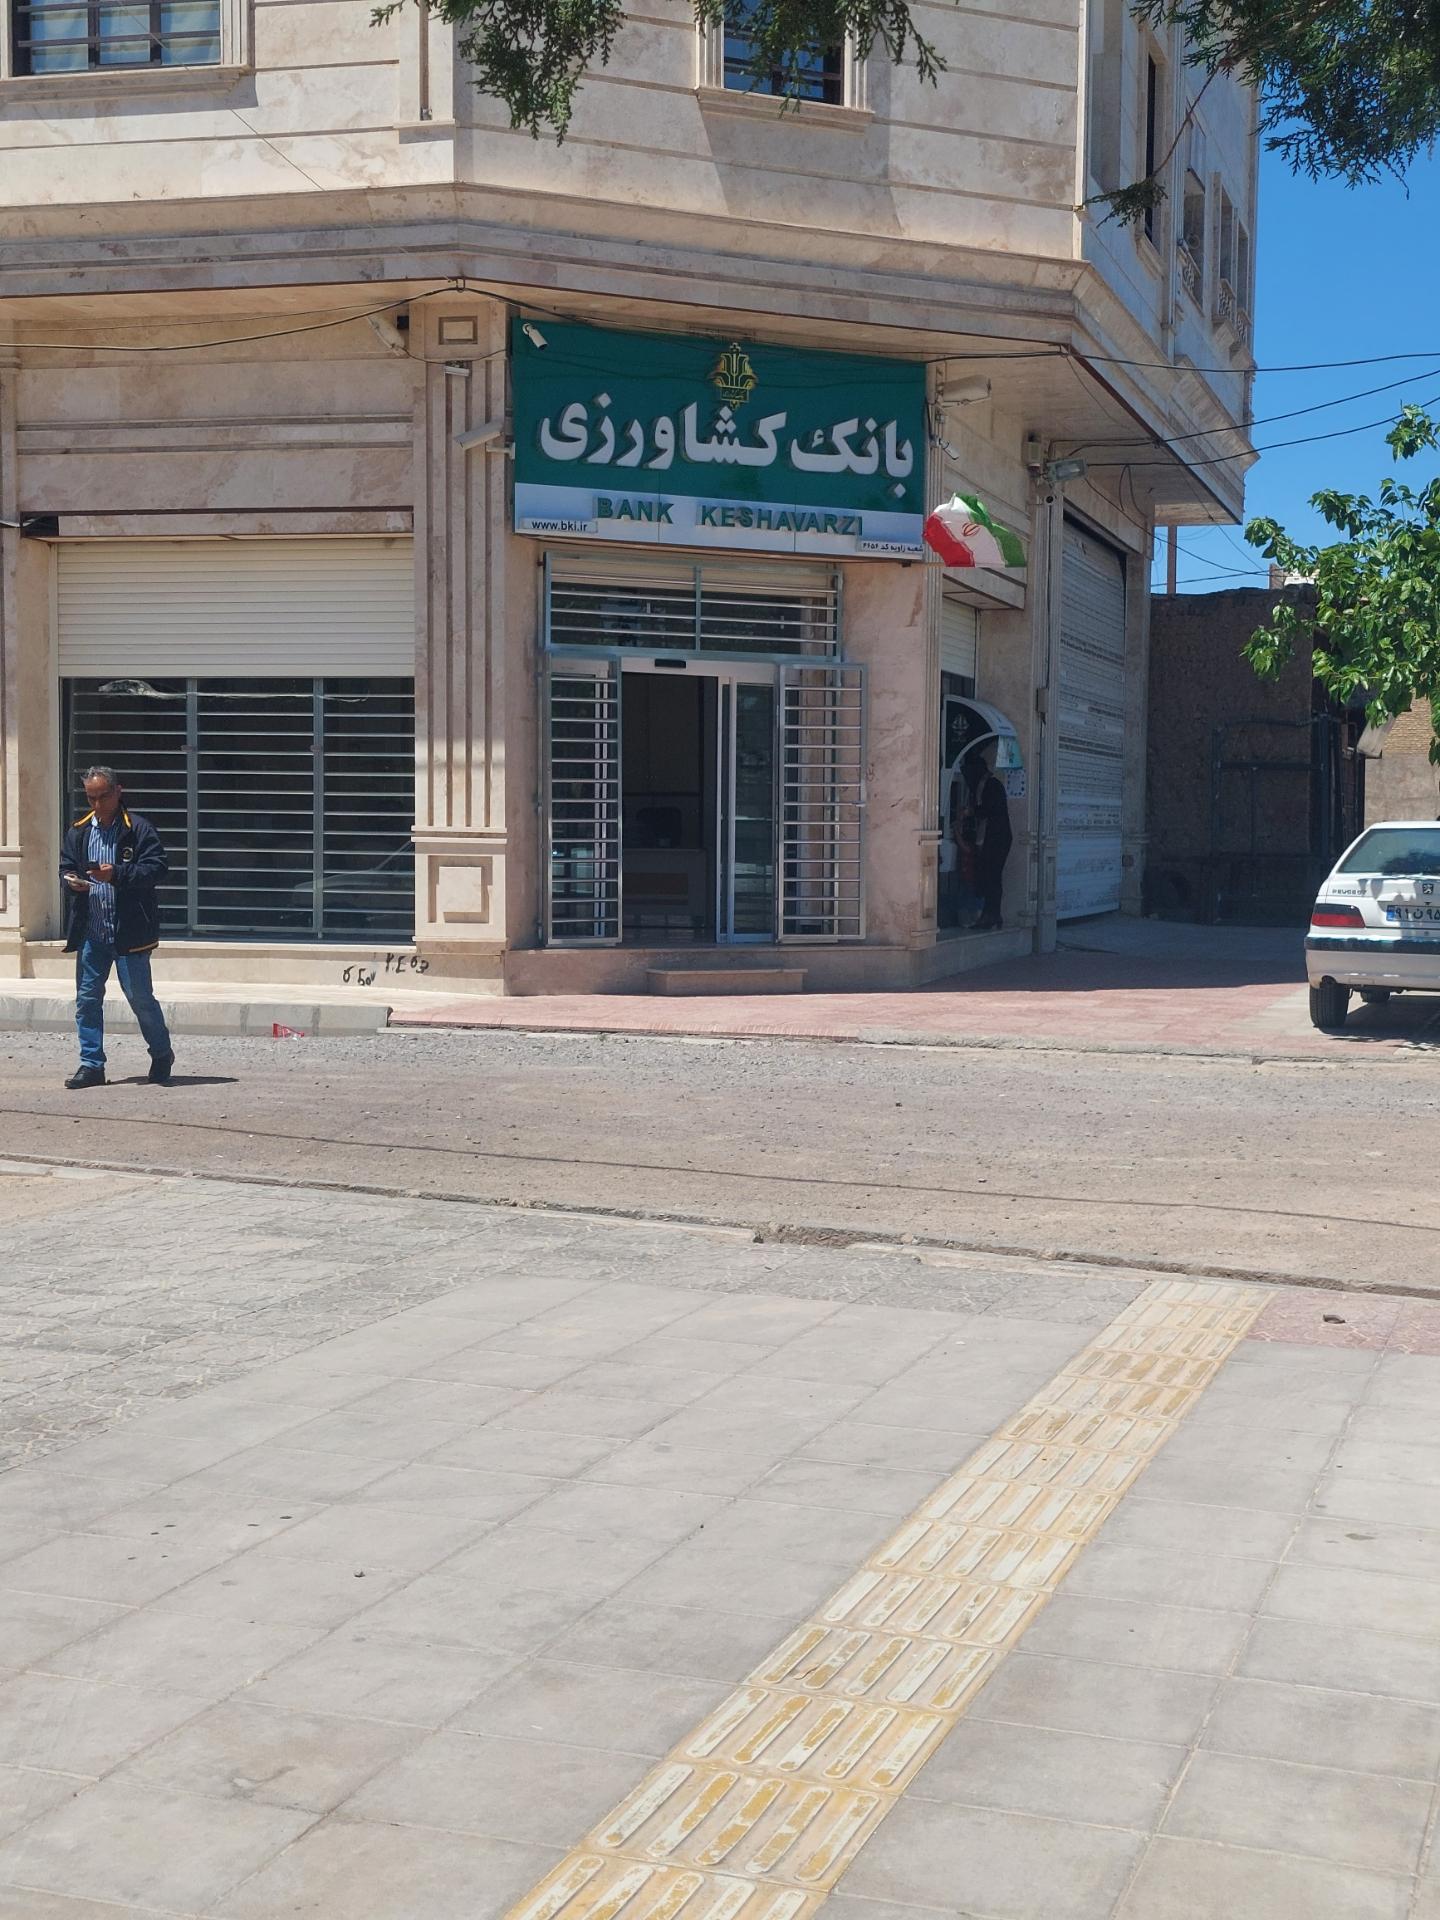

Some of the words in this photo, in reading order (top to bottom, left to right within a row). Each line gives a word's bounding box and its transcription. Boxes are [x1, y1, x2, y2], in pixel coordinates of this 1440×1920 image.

[539, 392, 788, 471] کشاورزی
[790, 417, 914, 499] بانک
[531, 519, 588, 532] www.bki.ir
[596, 496, 674, 525] BANK
[700, 504, 863, 536] KESHAVARZI
